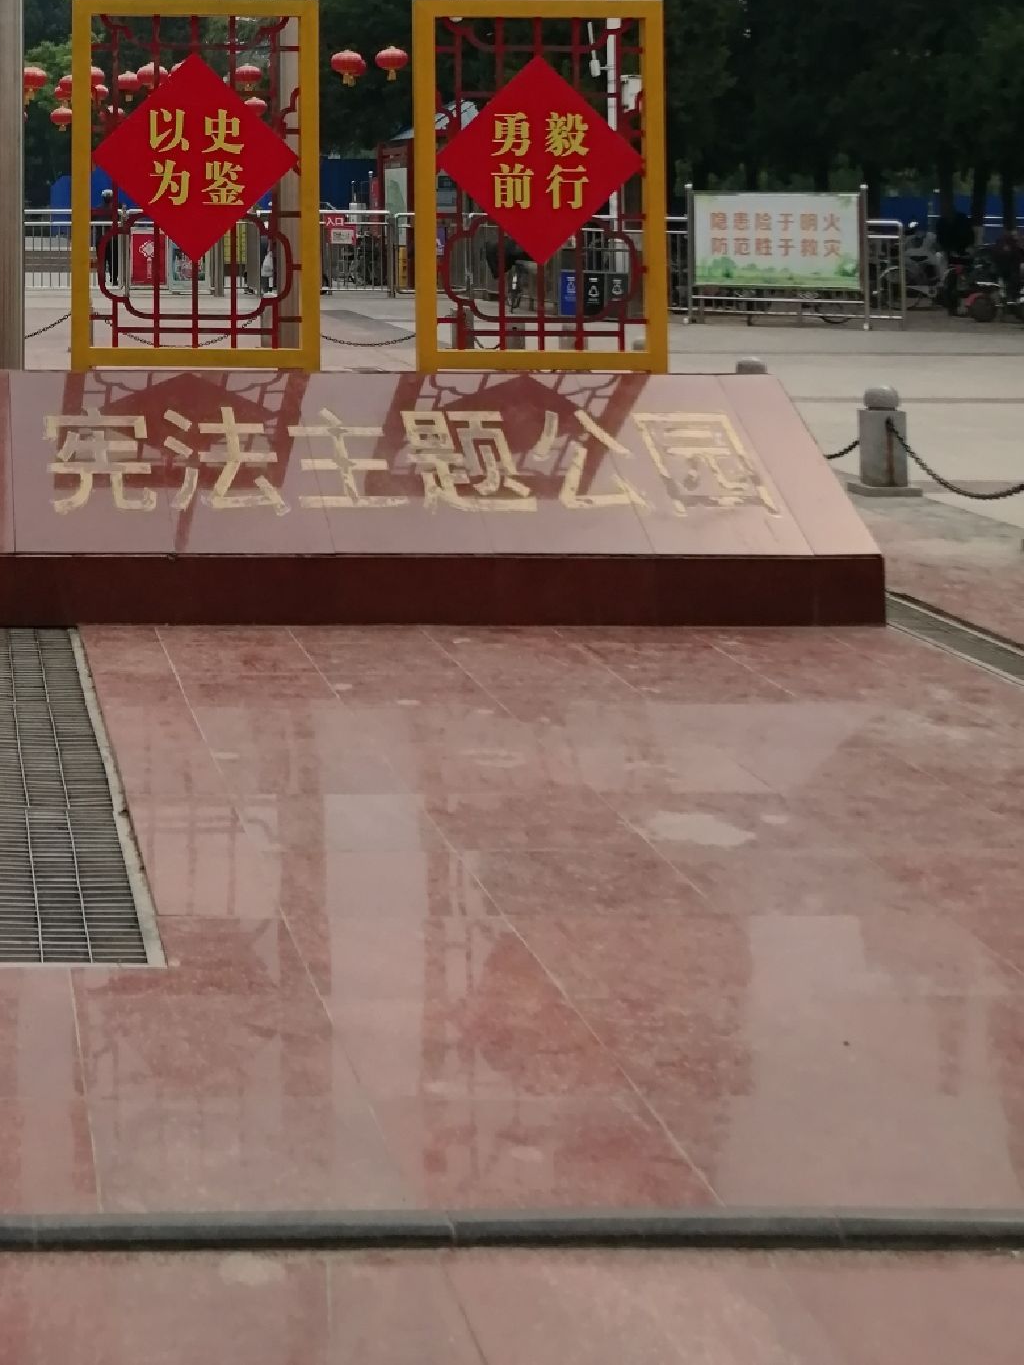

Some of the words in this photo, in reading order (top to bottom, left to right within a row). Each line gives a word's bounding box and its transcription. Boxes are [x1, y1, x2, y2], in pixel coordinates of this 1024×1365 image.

[149, 108, 245, 155] 以史
[490, 112, 590, 157] 勇毅
[148, 159, 246, 206] 为鉴
[490, 163, 590, 210] 前行
[326, 216, 345, 226] 入口
[710, 212, 842, 232] 隐患险于明火
[711, 237, 842, 257] 防范胜于救灾
[42, 405, 782, 518] 宪法主题公园
